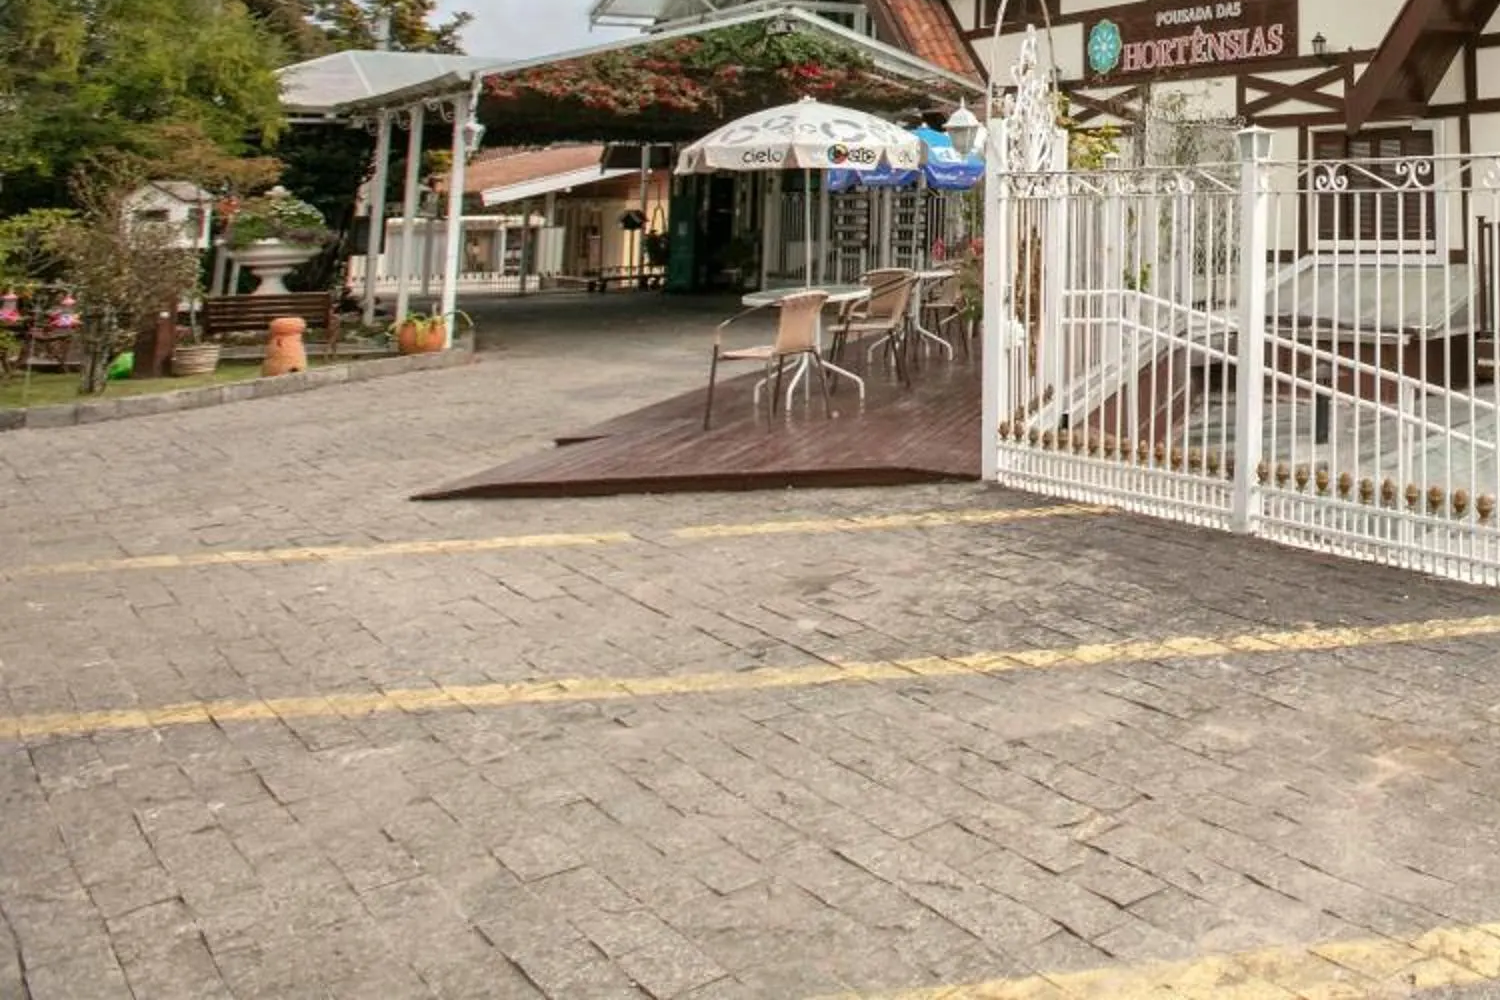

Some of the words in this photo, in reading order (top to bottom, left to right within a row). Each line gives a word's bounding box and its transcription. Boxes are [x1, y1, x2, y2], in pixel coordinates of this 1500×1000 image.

[1155, 5, 1213, 27] POUSADA
[1216, 1, 1242, 19] DAS
[1122, 23, 1284, 72] HORTÊNSIAS
[741, 147, 783, 164] cielo
